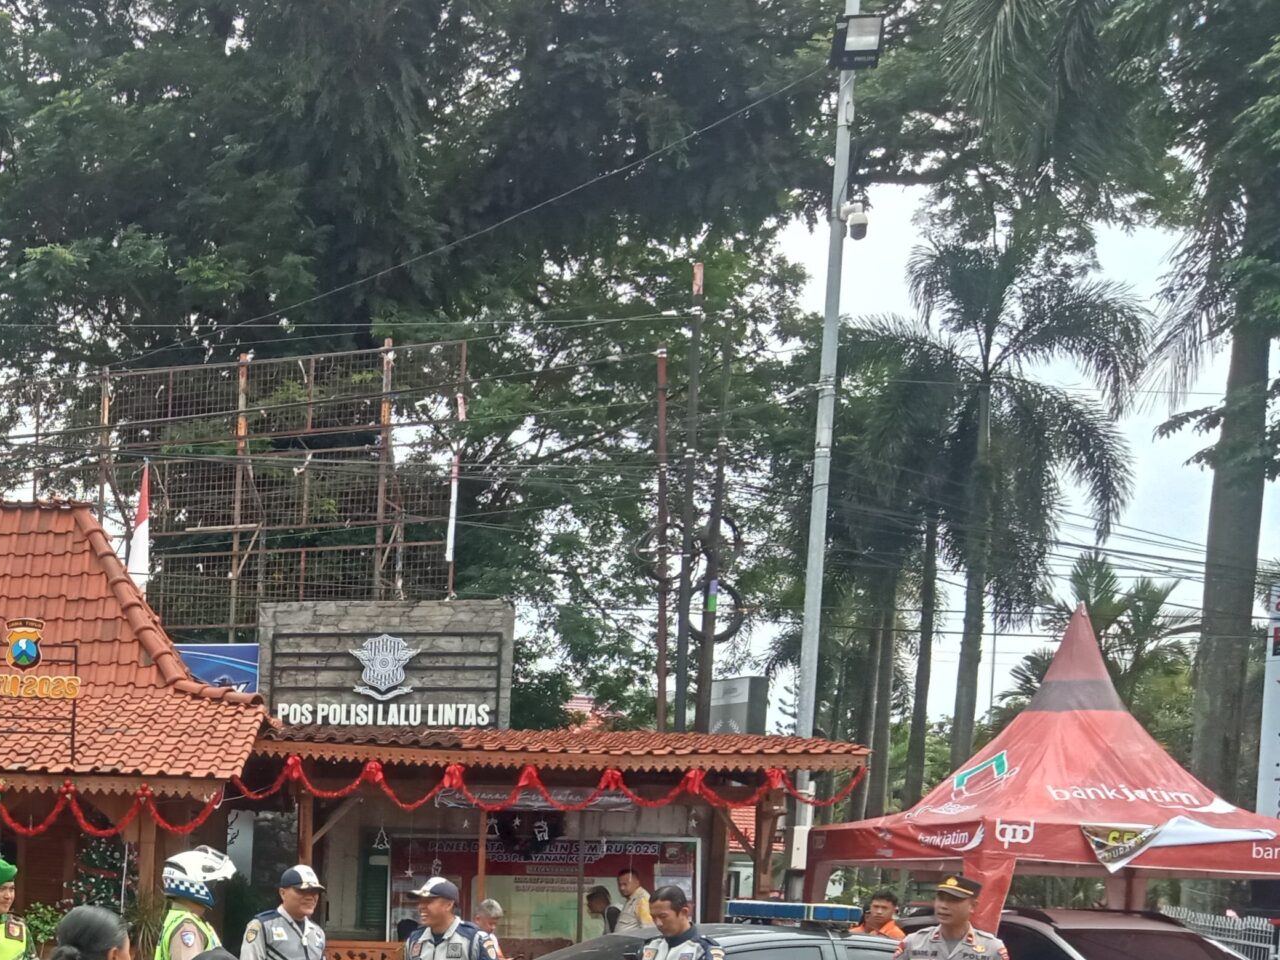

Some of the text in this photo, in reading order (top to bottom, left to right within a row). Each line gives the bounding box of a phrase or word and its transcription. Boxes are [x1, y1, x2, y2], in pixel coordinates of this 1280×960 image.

[277, 703, 490, 726] POS POLISI LALU LINTAS
[1046, 784, 1200, 805] bankjatim
[429, 842, 468, 853] PANEL
[471, 842, 505, 853] DTA
[625, 843, 660, 855] 2025
[511, 853, 567, 863] PEYANAN
[963, 952, 990, 960] POLRI
